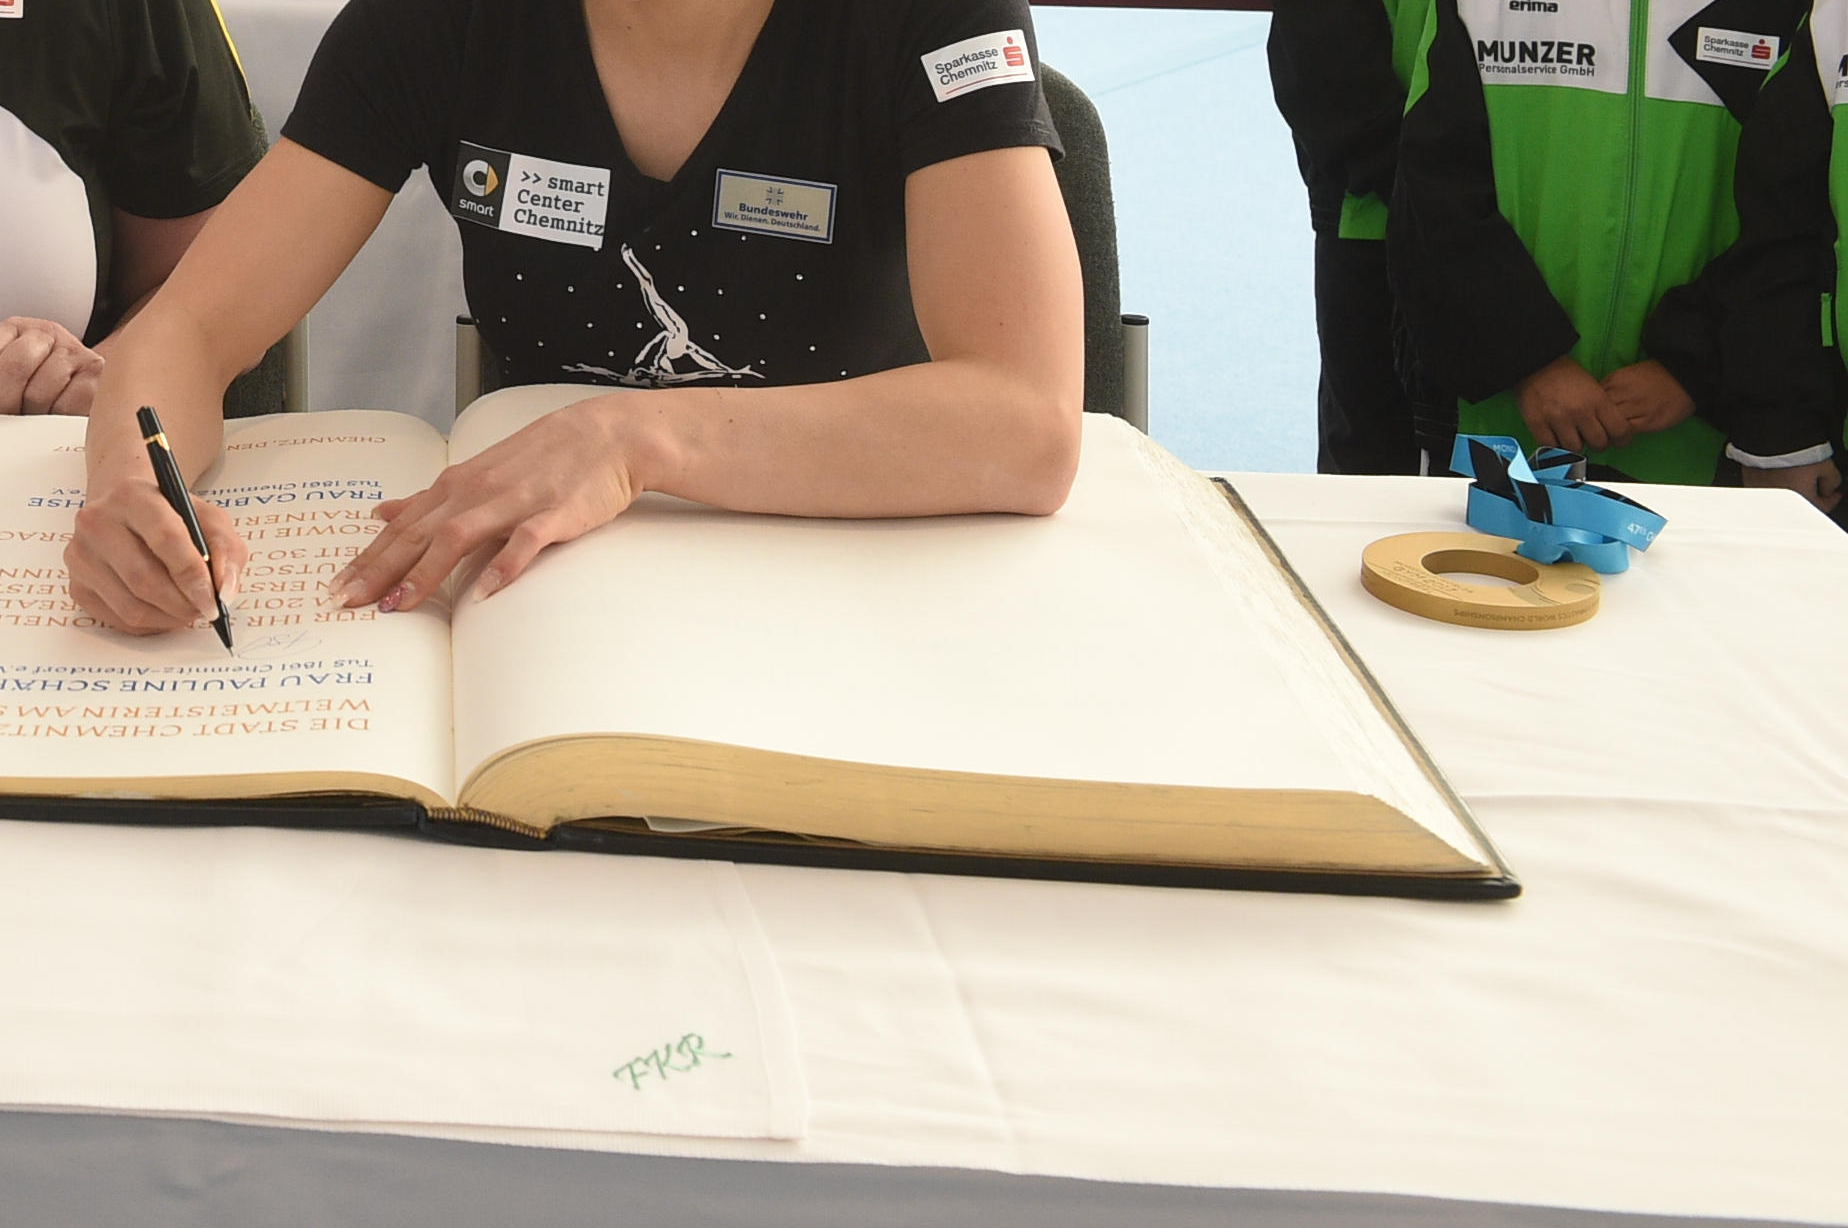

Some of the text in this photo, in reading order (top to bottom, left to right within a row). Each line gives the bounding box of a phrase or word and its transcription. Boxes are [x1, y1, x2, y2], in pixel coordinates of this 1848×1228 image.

[1703, 35, 1749, 50] Sparkasse
[1703, 43, 1745, 57] Chemnitz
[933, 45, 999, 76] Sparkasse
[1477, 40, 1596, 66] MUNZER
[938, 58, 999, 86] Chemnitz
[1478, 62, 1595, 77] Personalservice GmbH
[547, 174, 605, 198] smart
[458, 196, 495, 218] smart
[517, 189, 585, 214] Center
[739, 202, 808, 221] Bundeswehr
[513, 208, 606, 237] Chemnitz
[724, 211, 821, 232] Wir. Dienen. Deutschland.
[226, 440, 269, 452] DEN
[302, 479, 340, 489] 1861
[346, 479, 382, 488] TuS
[306, 490, 384, 502] FRAU
[274, 524, 381, 538] SOWIE
[263, 548, 307, 560] 30
[234, 597, 305, 611] 2017
[245, 613, 302, 628] IHR
[314, 609, 377, 623] FÜR
[1452, 608, 1526, 623] CHAMPIONSHIPS
[31, 663, 273, 677] Chemnitz-Altendorf
[280, 661, 324, 672] 1861
[333, 658, 373, 670] TuS
[119, 676, 267, 693] PAULINE
[279, 672, 372, 687] FRAU
[17, 704, 79, 718] AM
[81, 698, 372, 720] WELTMEISTERIN
[193, 719, 298, 737] STADT
[309, 717, 370, 732] DIE
